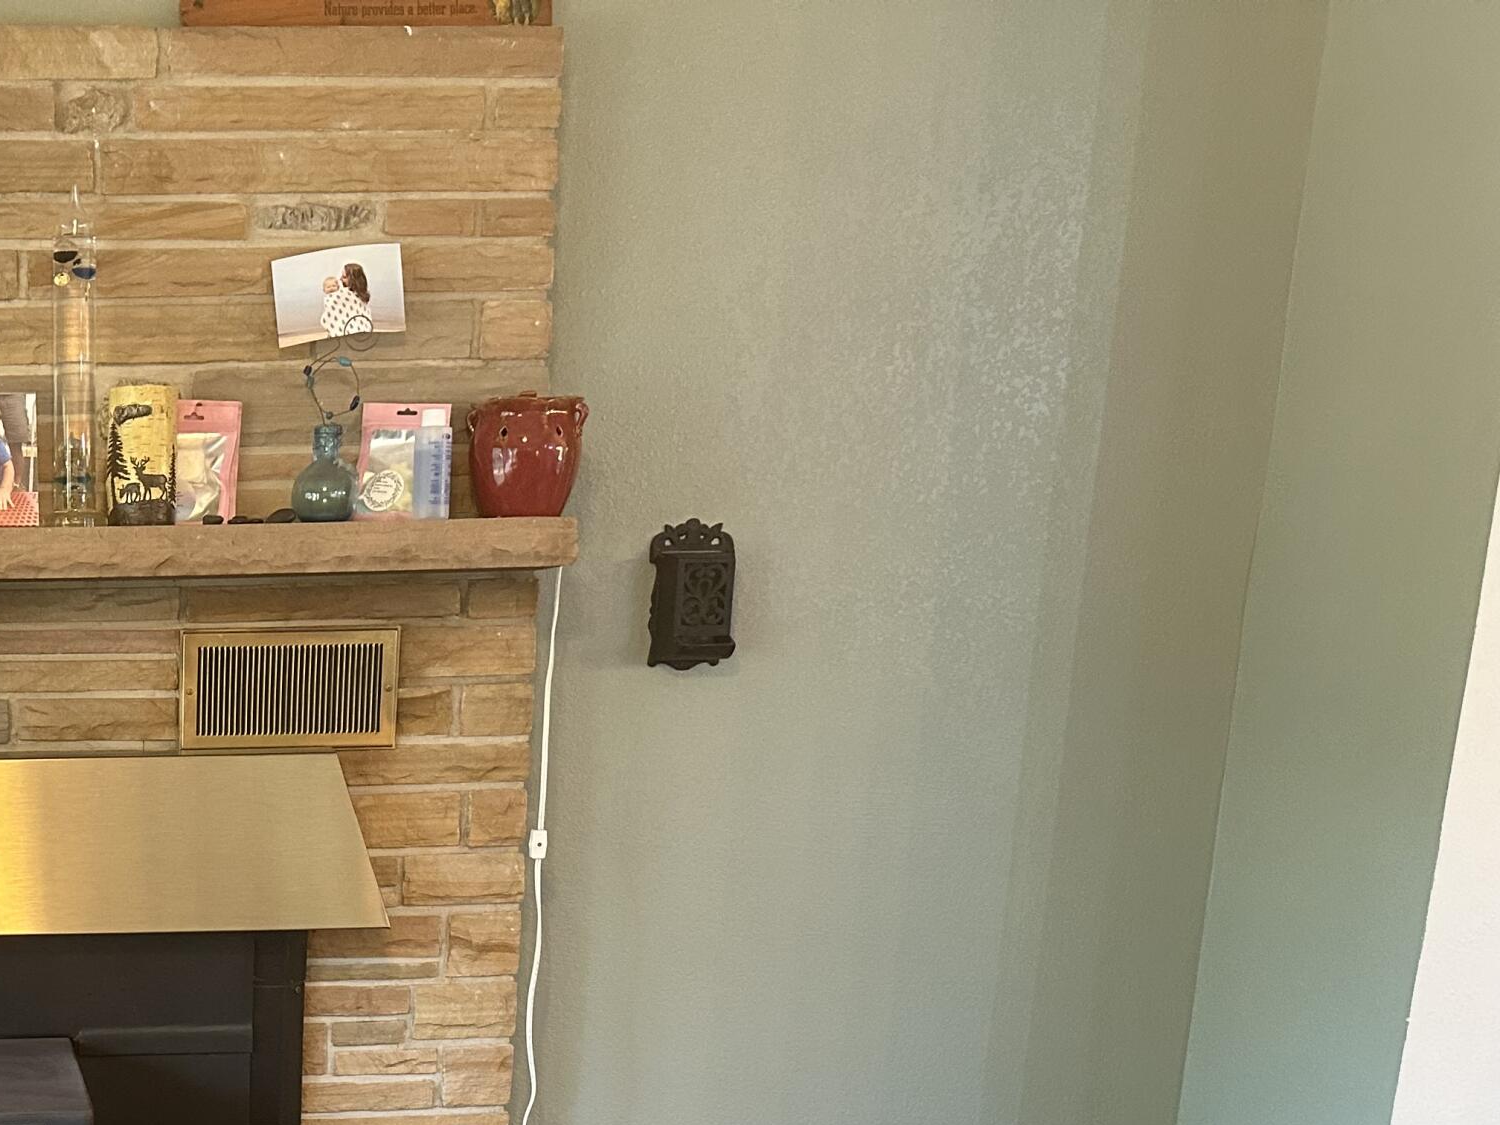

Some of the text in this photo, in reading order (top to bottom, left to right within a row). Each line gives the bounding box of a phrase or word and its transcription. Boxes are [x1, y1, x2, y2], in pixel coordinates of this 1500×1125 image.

[324, 2, 478, 18] Nature provides a better place.
